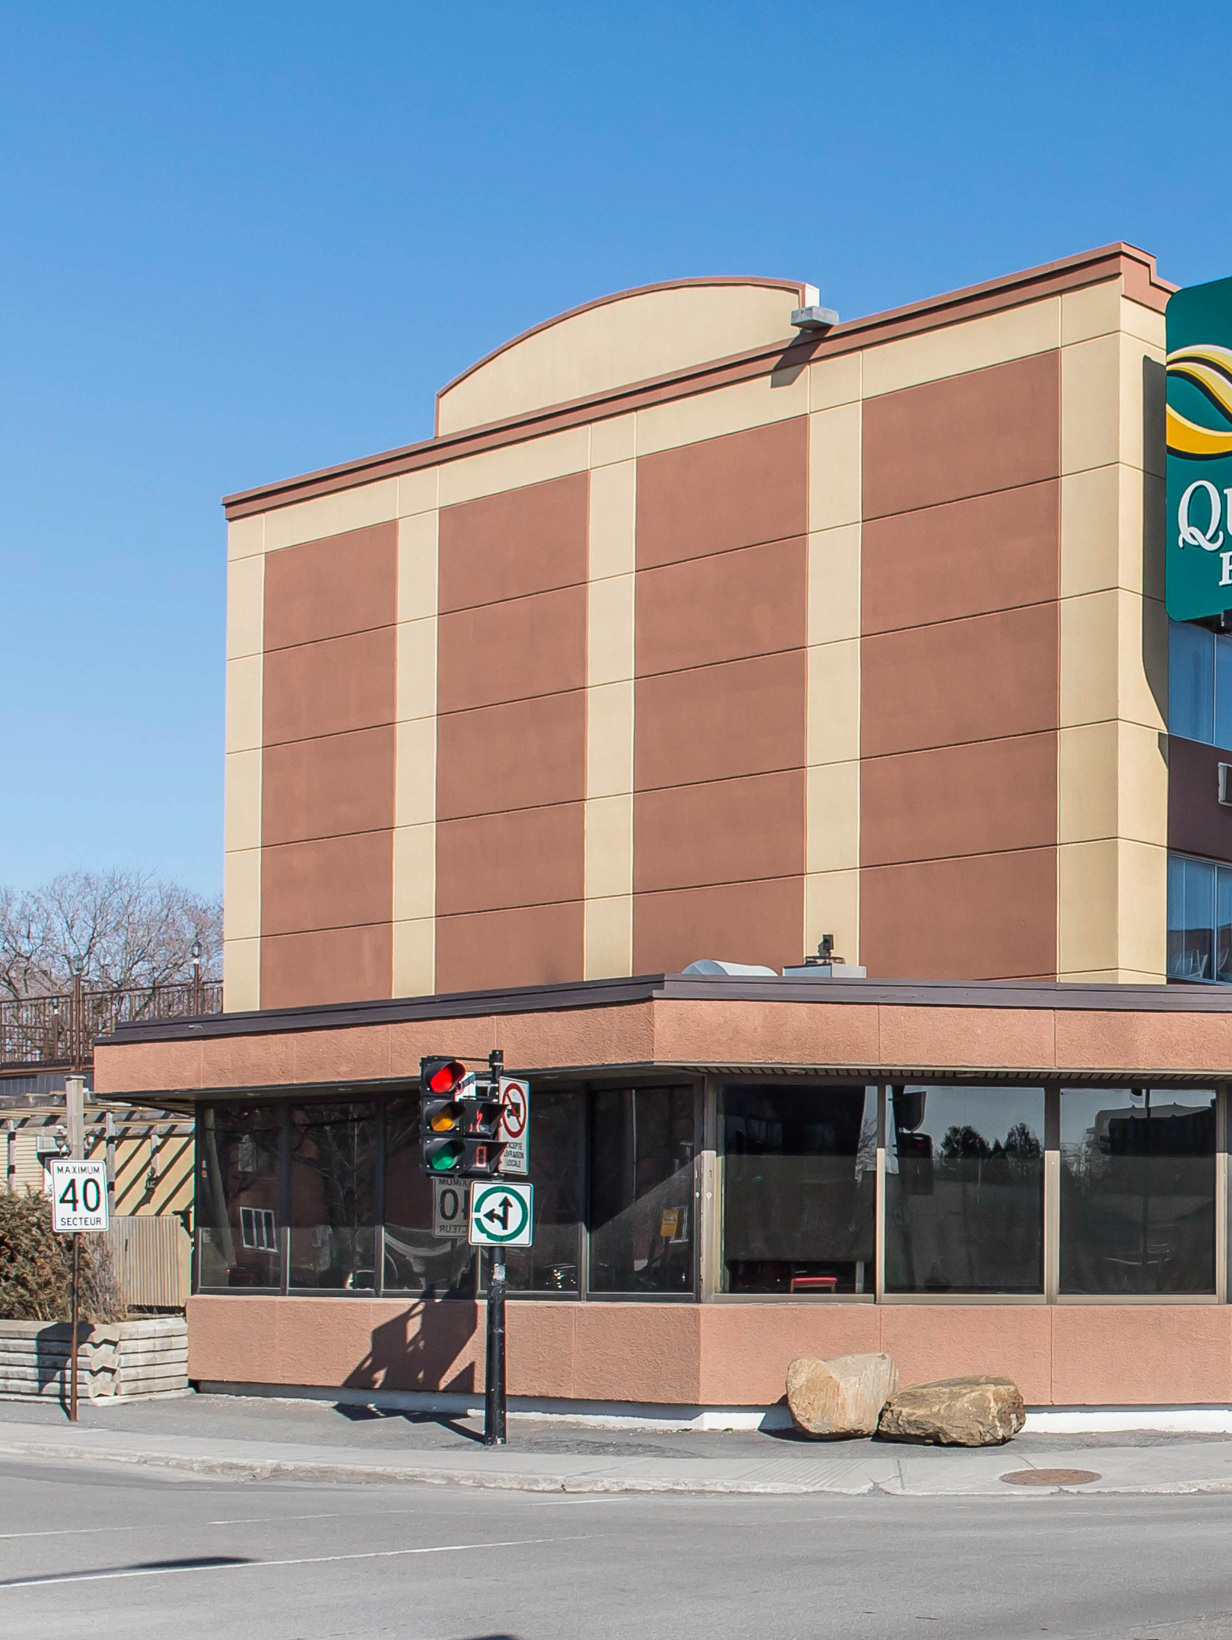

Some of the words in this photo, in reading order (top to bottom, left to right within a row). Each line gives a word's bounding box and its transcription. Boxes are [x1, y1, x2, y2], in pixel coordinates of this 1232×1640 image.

[57, 1166, 99, 1174] MAXIMUM
[59, 1178, 101, 1212] 40
[61, 1217, 101, 1226] SECTEUR
